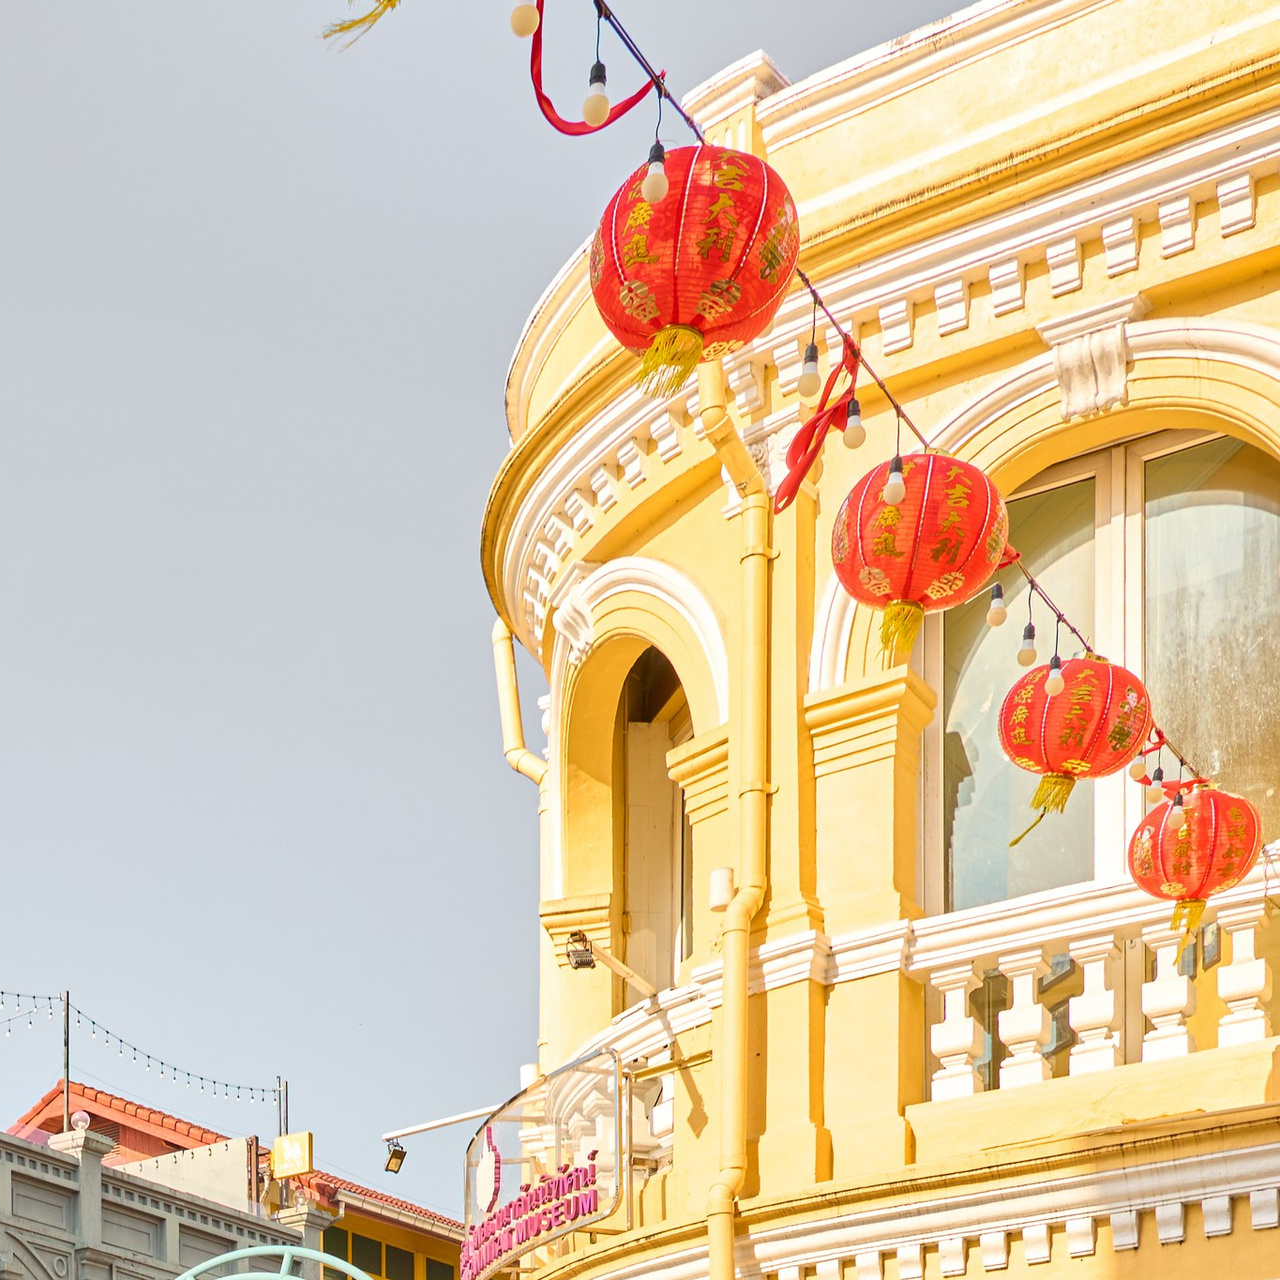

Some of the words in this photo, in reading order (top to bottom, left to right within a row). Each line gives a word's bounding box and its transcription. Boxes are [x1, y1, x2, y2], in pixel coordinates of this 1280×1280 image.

[696, 150, 750, 262] 大吉大利
[931, 465, 972, 565] 大吉大利
[1059, 668, 1099, 748] 大吉大利
[515, 1189, 598, 1245] MUSEUM
